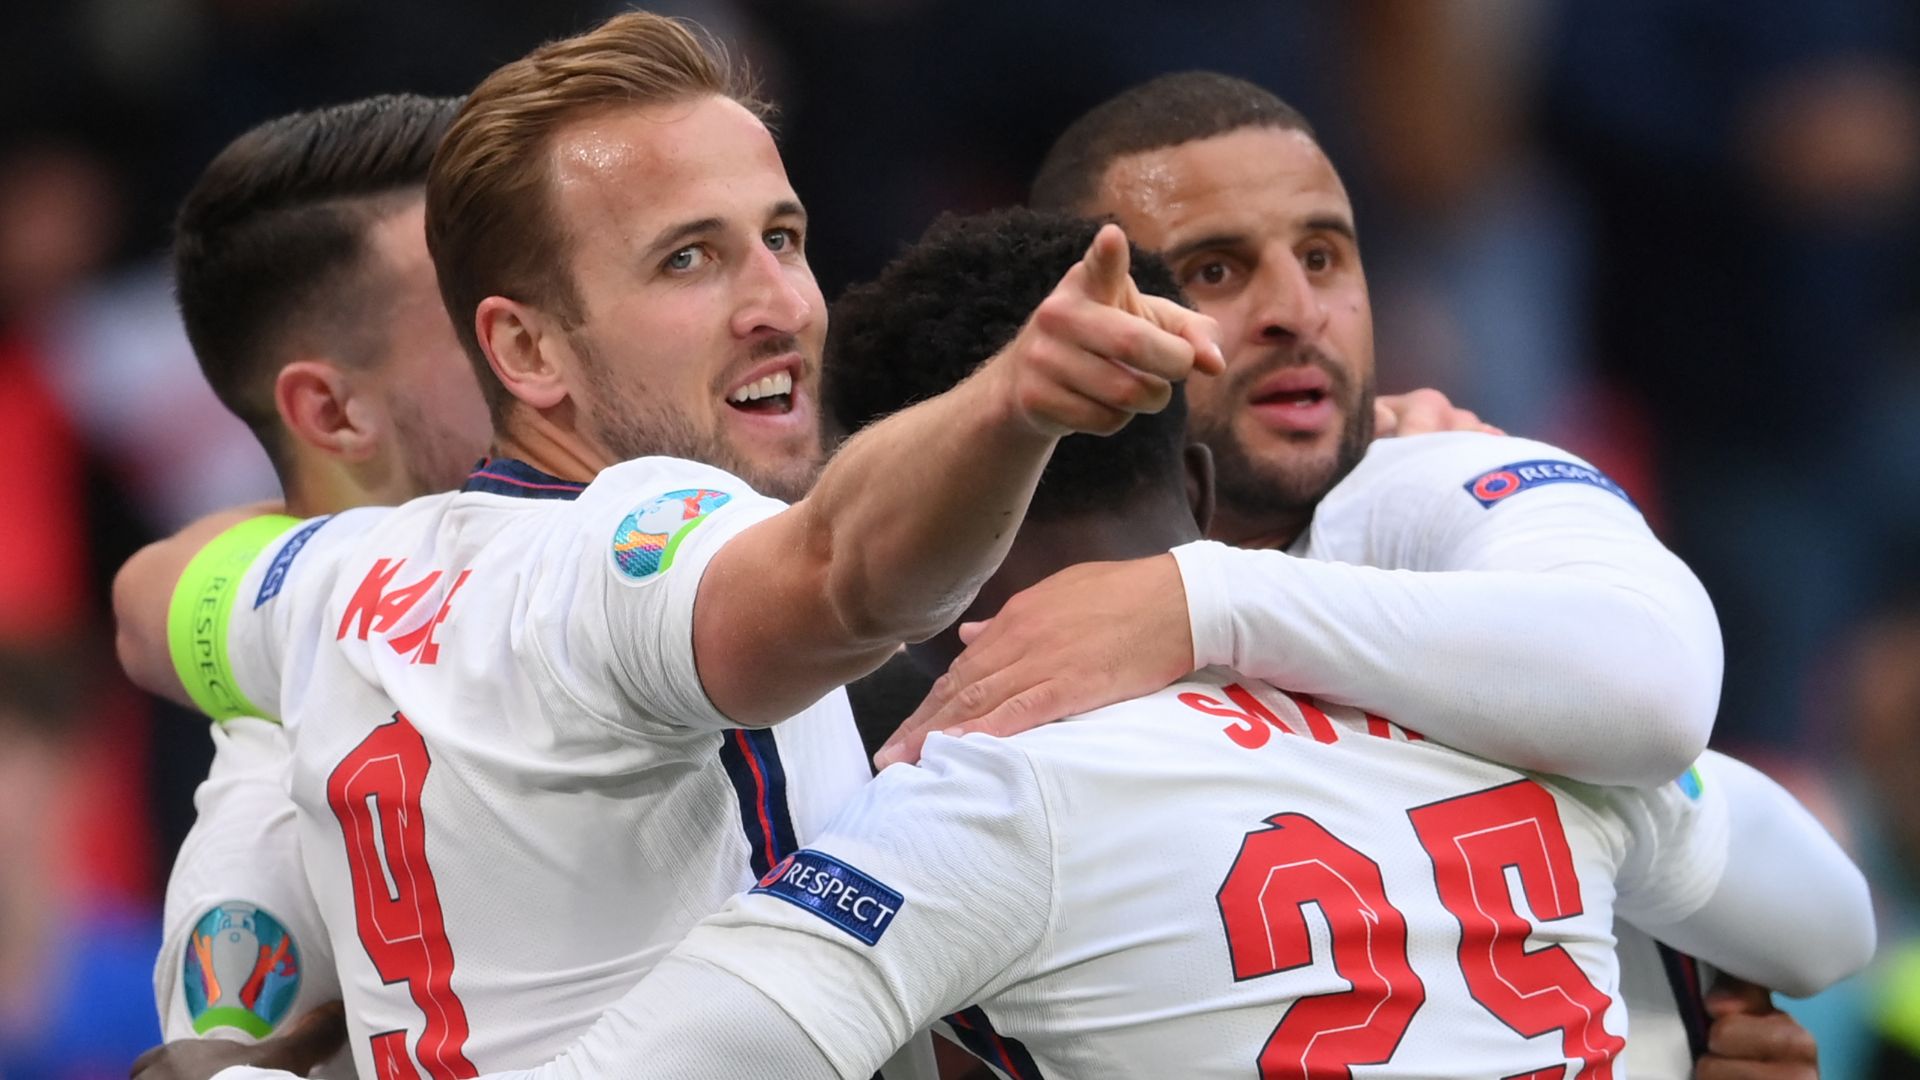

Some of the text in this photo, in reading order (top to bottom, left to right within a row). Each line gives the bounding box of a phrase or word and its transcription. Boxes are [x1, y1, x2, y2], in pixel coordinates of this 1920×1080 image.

[336, 557, 473, 665] KAE
[326, 710, 480, 1080] 9
[783, 862, 895, 929] RESPECT
[1216, 778, 1626, 1080] 25
